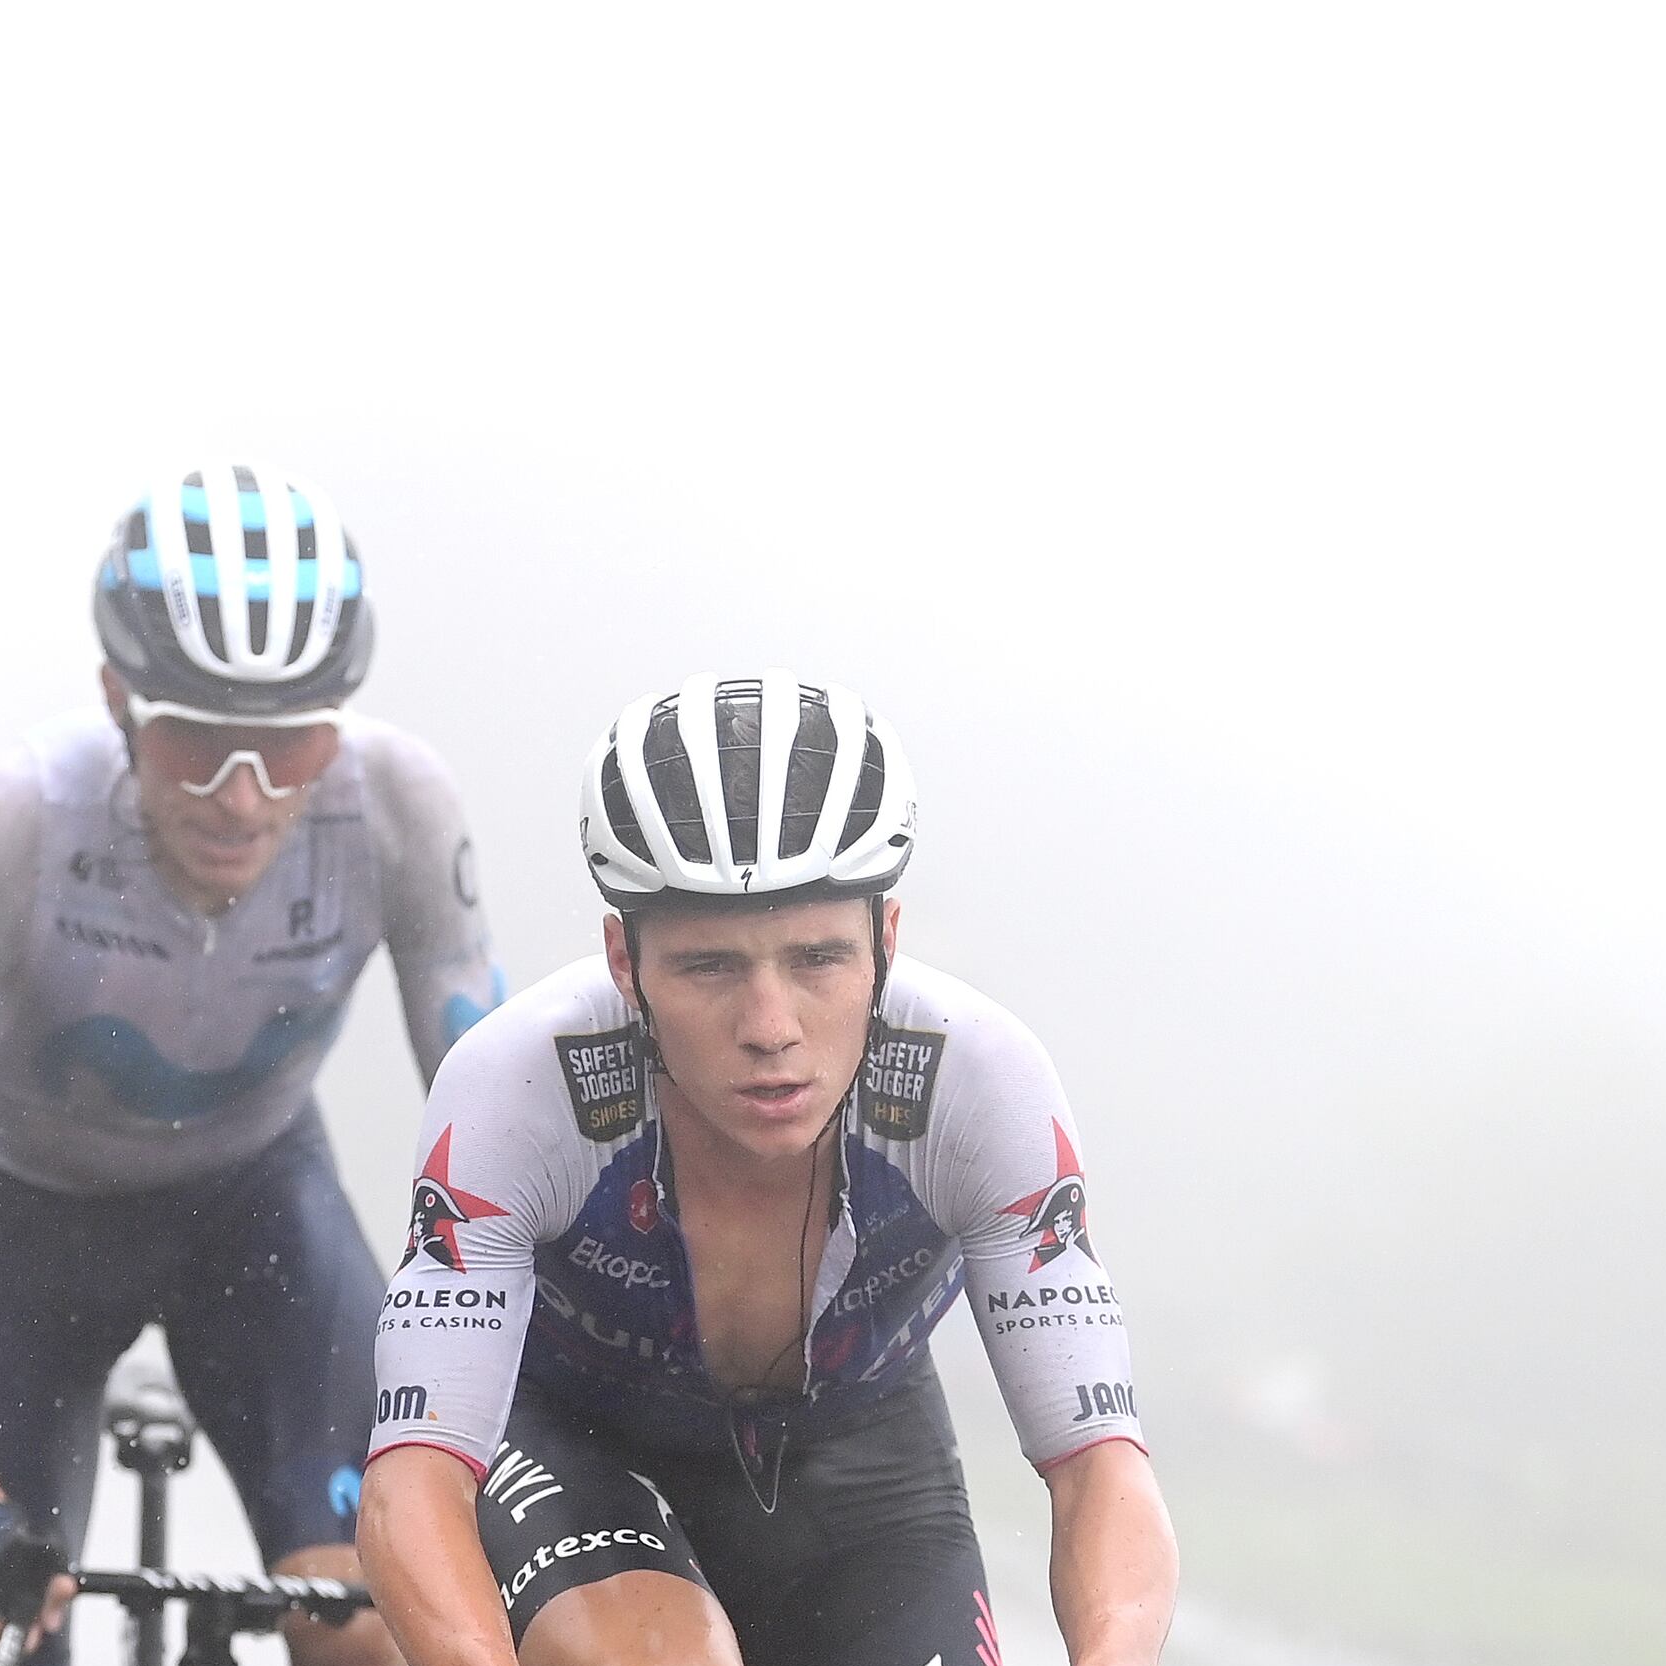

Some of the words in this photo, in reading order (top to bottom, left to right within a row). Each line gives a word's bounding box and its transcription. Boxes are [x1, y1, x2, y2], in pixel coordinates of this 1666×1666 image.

[383, 1289, 506, 1312] POLEON
[401, 1319, 411, 1329] &
[420, 1316, 502, 1331] CASINO
[996, 1313, 1078, 1335] SPORTS
[1085, 1315, 1094, 1325] &
[1099, 1313, 1123, 1326] CAS
[501, 1528, 666, 1611] latexco
